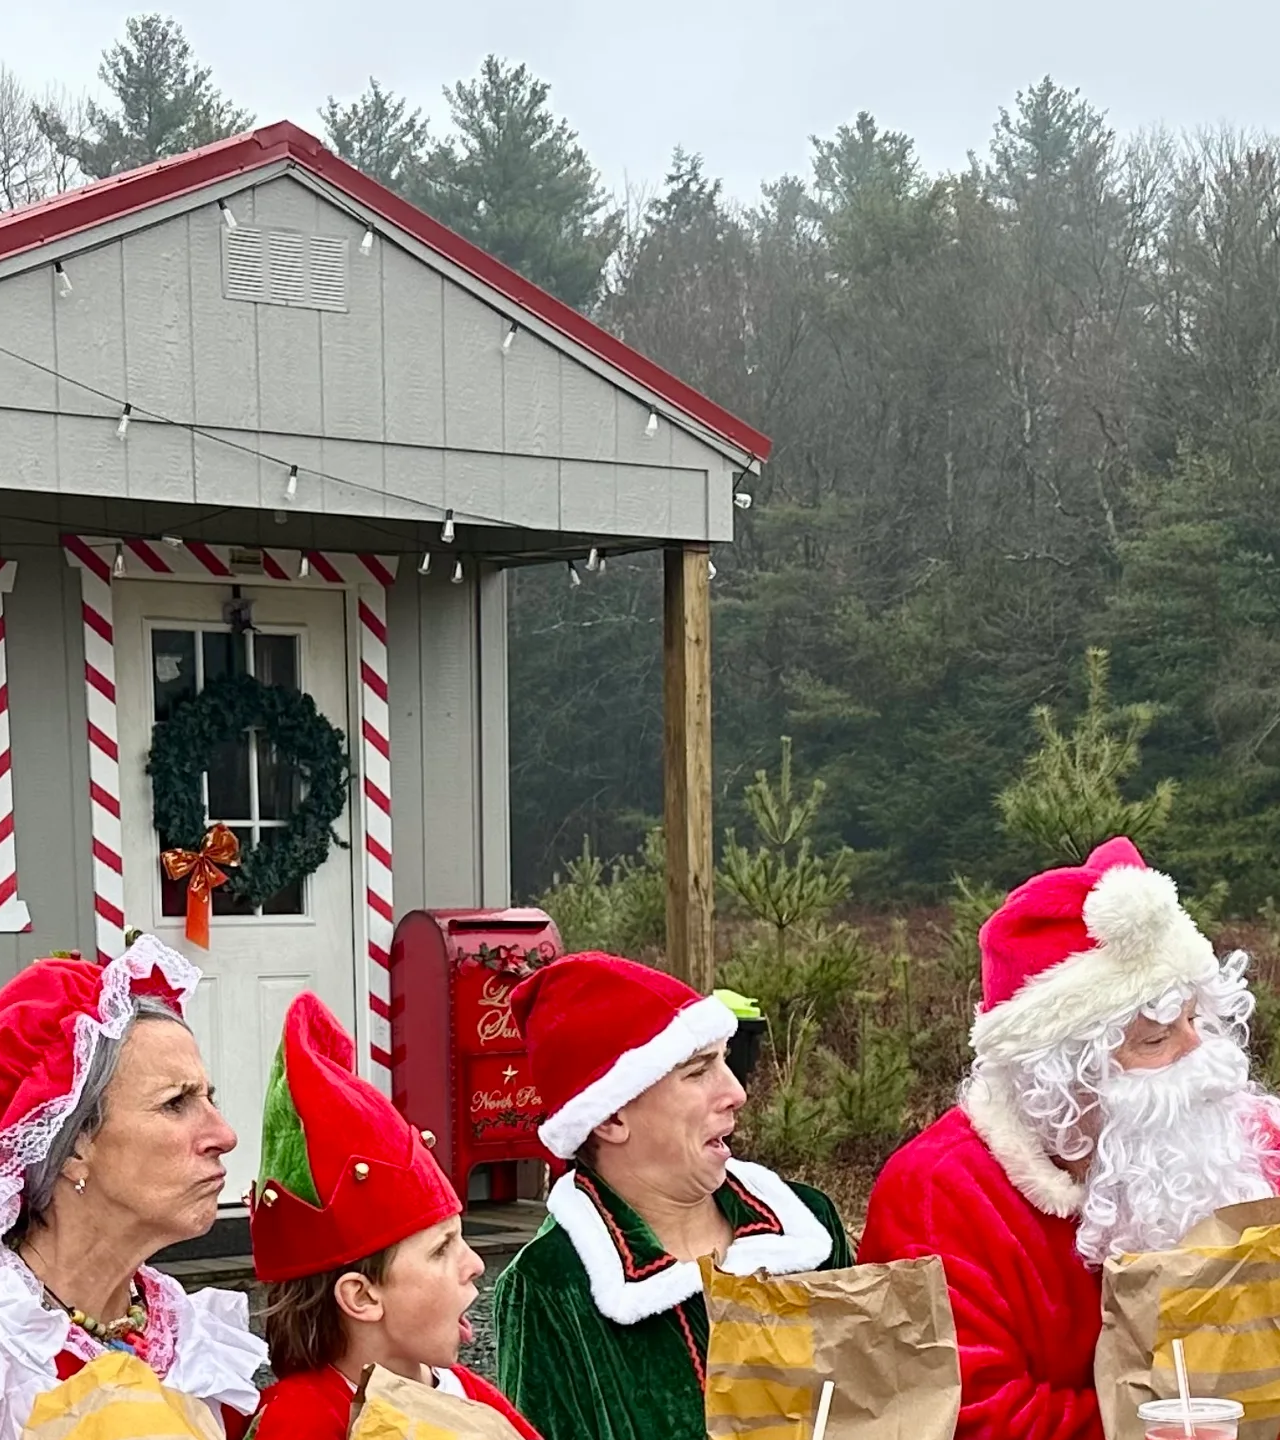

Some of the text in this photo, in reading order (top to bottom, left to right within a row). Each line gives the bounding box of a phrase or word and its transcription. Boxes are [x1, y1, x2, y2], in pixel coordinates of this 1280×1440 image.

[477, 1009, 518, 1046] San
[470, 1086, 542, 1112] North Po
